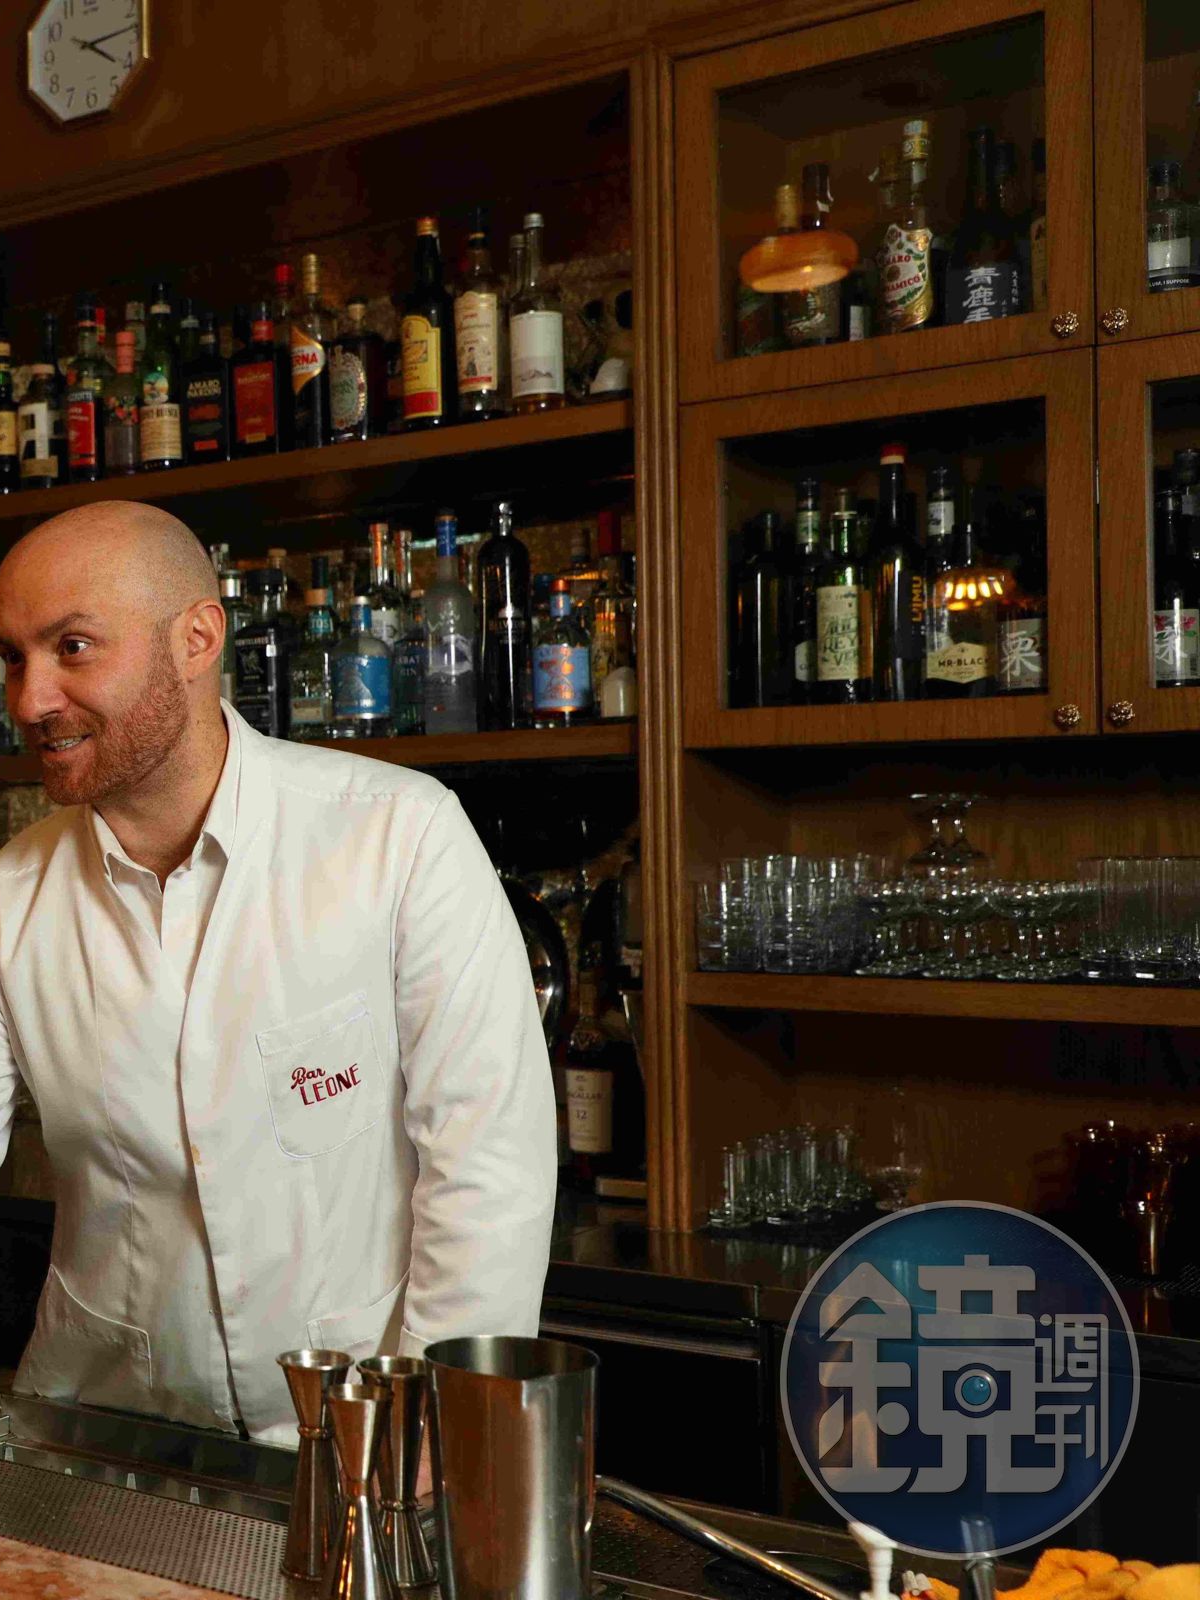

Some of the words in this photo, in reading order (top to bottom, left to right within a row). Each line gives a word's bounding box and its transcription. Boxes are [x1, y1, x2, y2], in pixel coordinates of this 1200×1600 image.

[123, 51, 134, 69] 4
[50, 73, 60, 94] 8
[66, 86, 76, 109] 7
[86, 87, 99, 109] 6
[291, 1067, 325, 1089] Bar
[300, 1063, 361, 1105] LEONE
